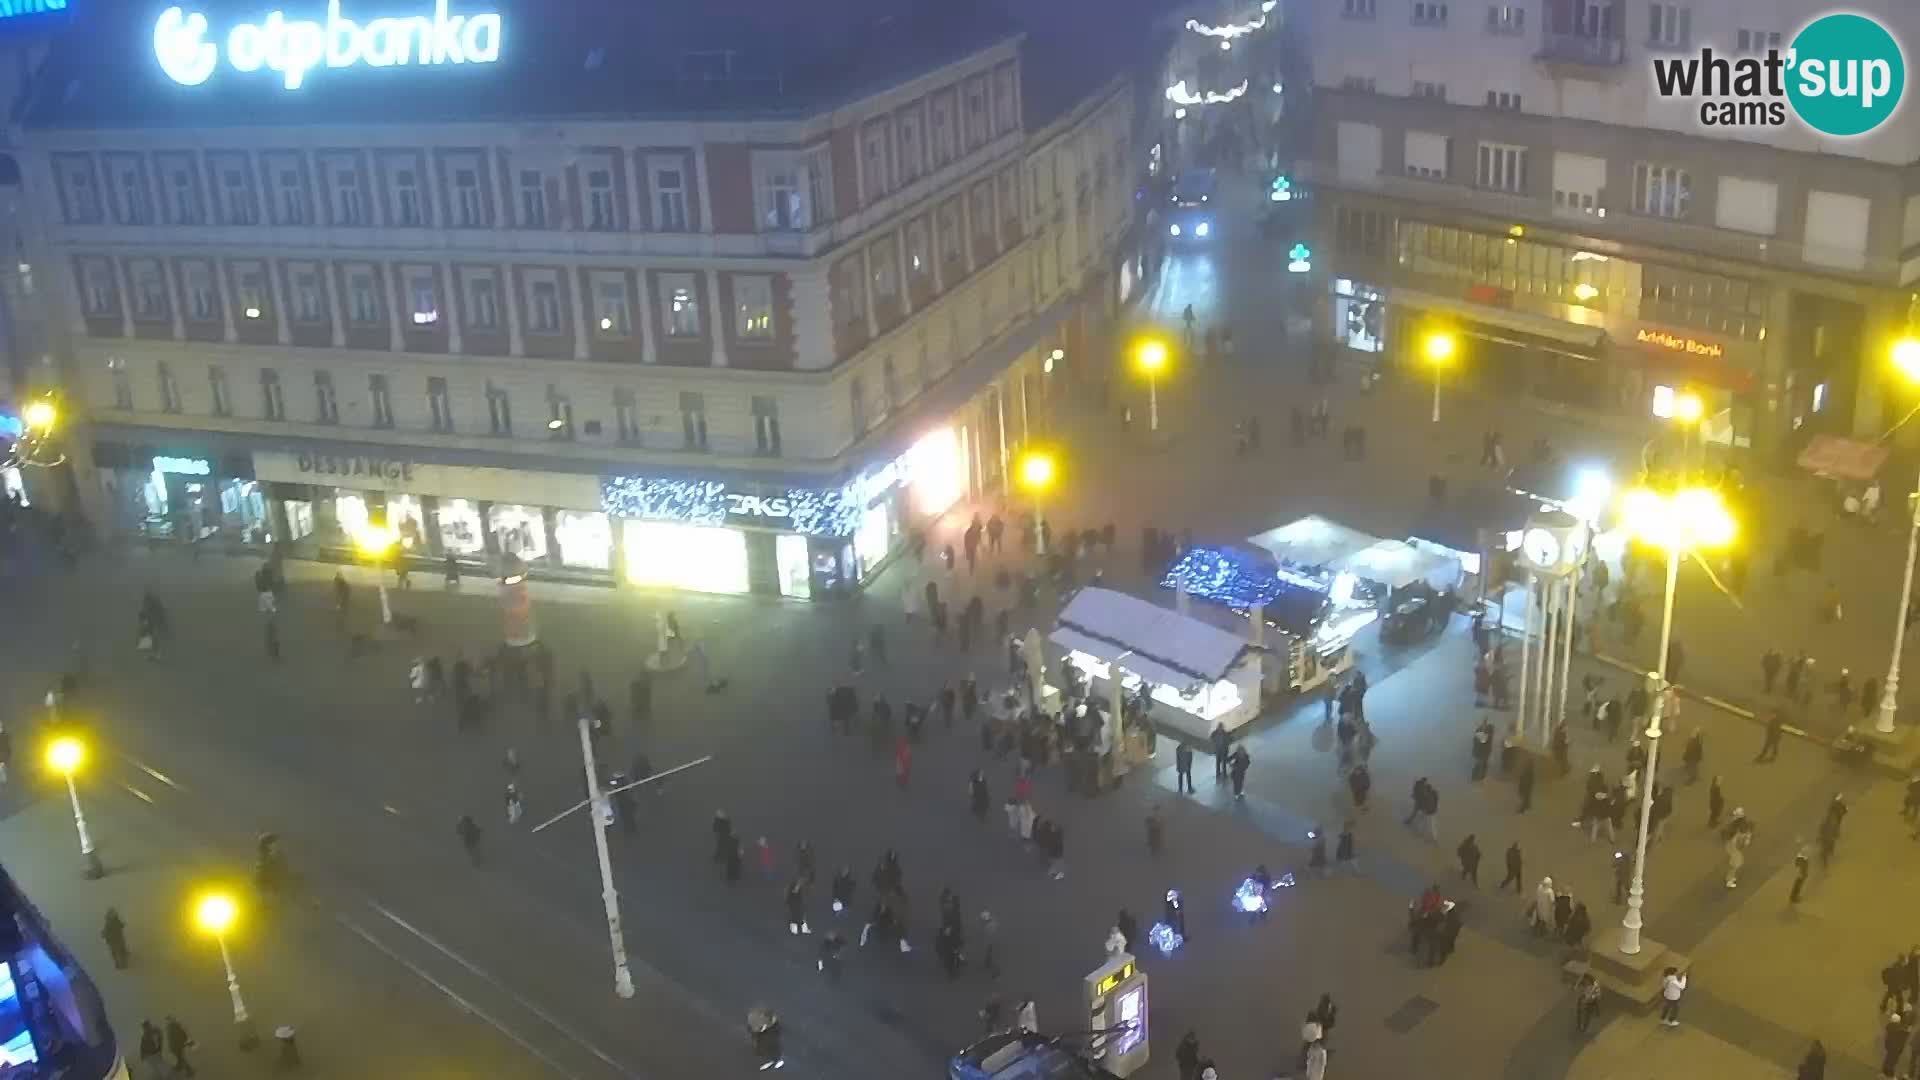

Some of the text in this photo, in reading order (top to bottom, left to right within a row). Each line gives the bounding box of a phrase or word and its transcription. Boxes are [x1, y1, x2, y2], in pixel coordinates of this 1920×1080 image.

[1686, 339, 1722, 357] Bank
[297, 455, 415, 481] DESSANGE
[726, 494, 790, 517] ZAKS
